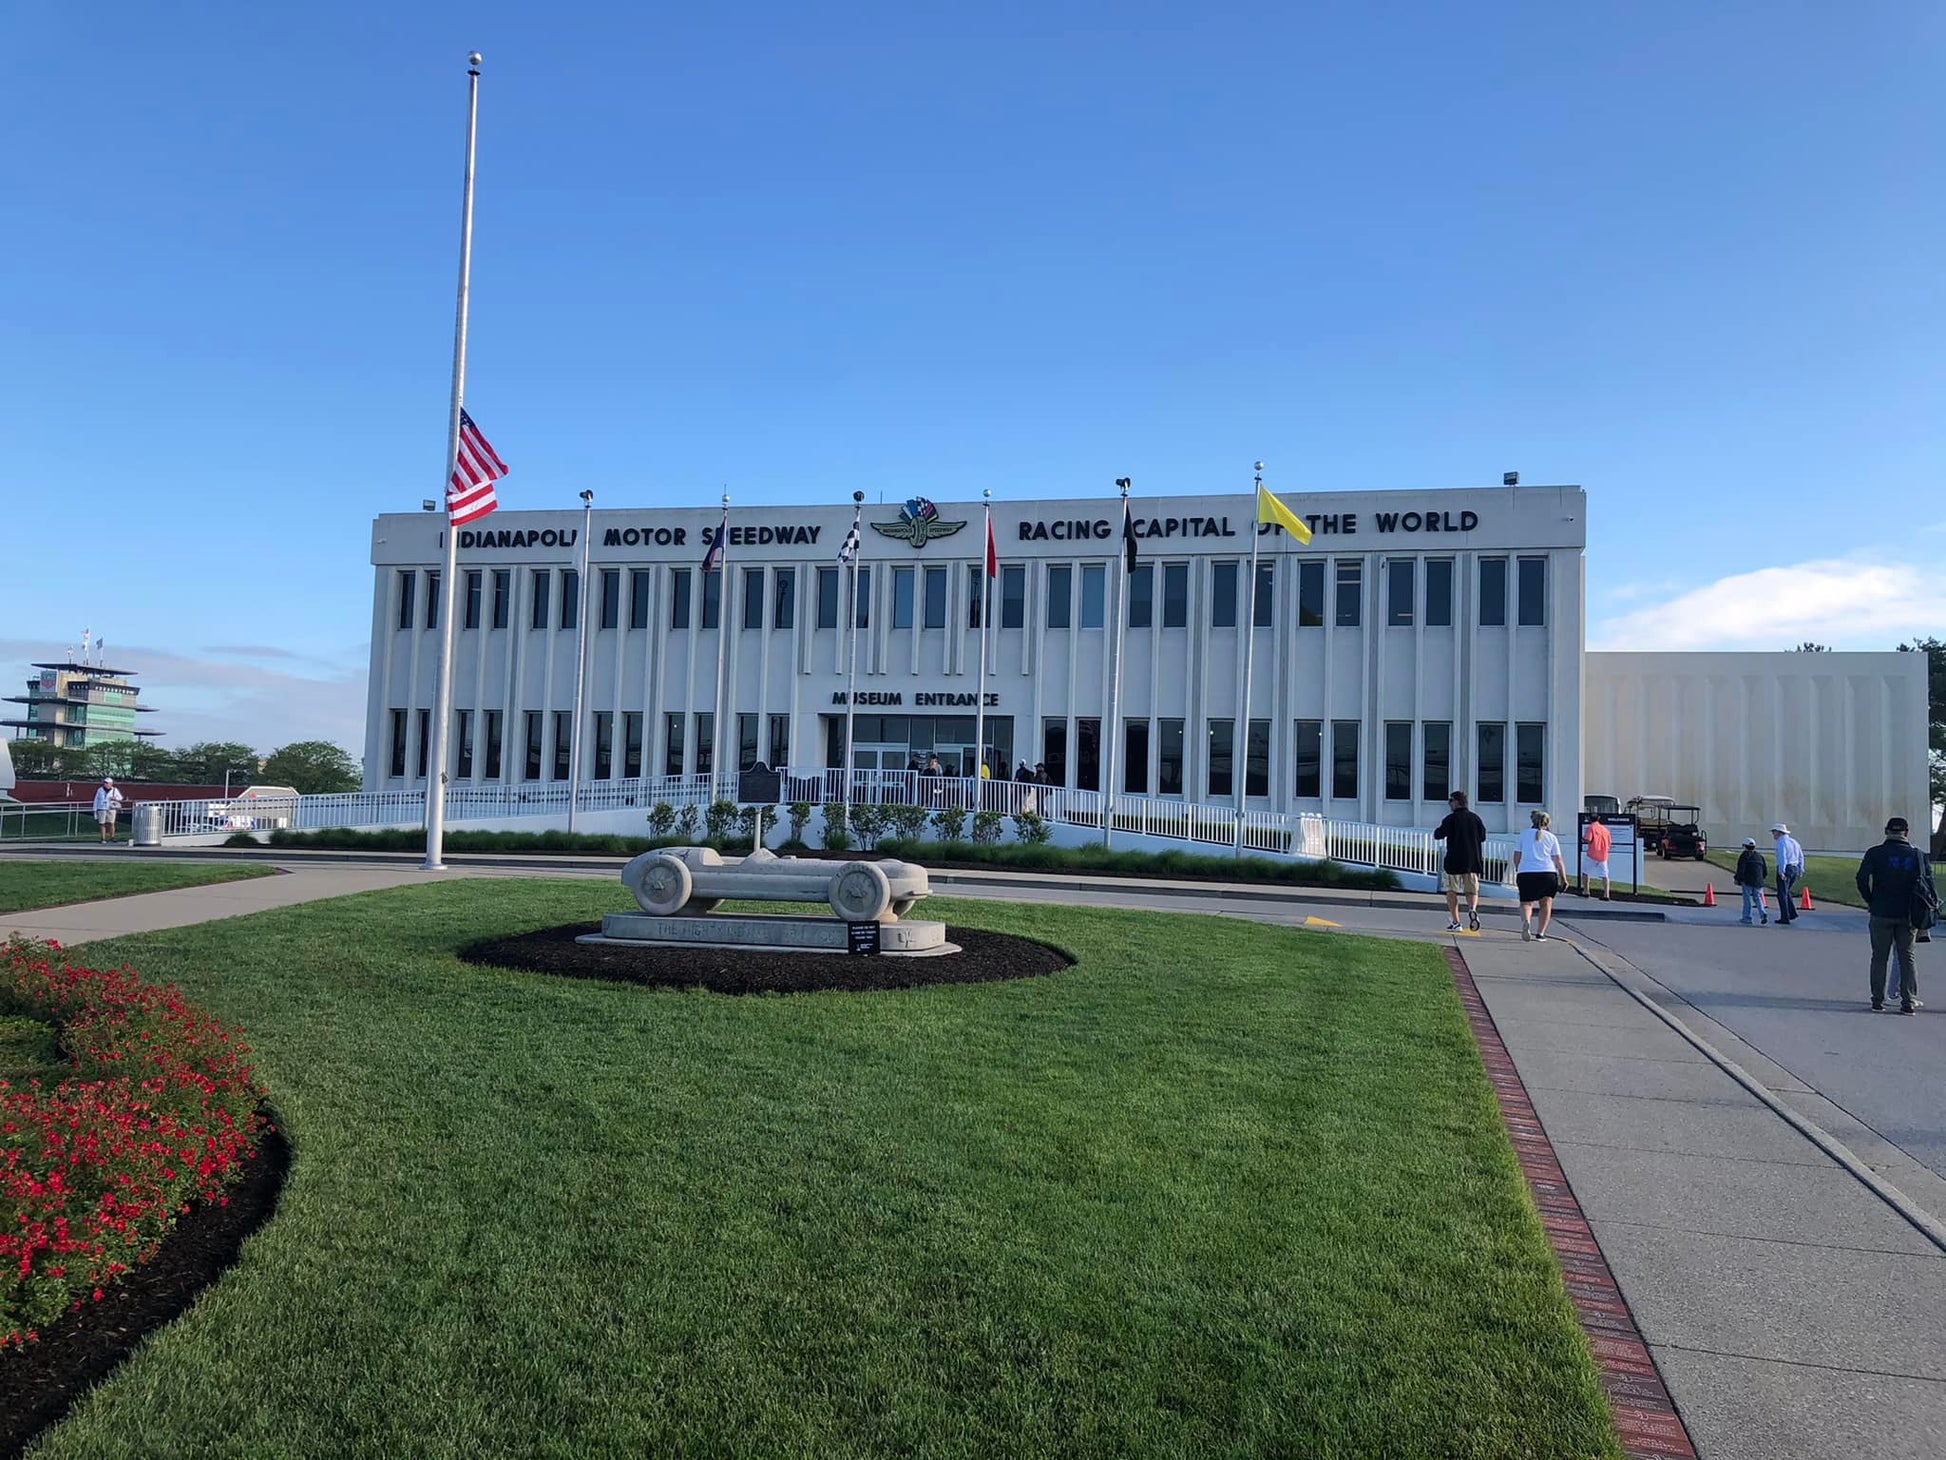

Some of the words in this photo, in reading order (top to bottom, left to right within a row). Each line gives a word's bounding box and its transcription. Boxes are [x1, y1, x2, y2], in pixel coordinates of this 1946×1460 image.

[1019, 519, 1112, 541] RACING
[1132, 516, 1236, 538] CAPITAL
[1305, 513, 1357, 535] THE
[1375, 510, 1479, 533] WORLD
[439, 528, 580, 549] IDIANAPOLI
[603, 527, 687, 546] MOTOR
[915, 692, 999, 707] ENTRANCE
